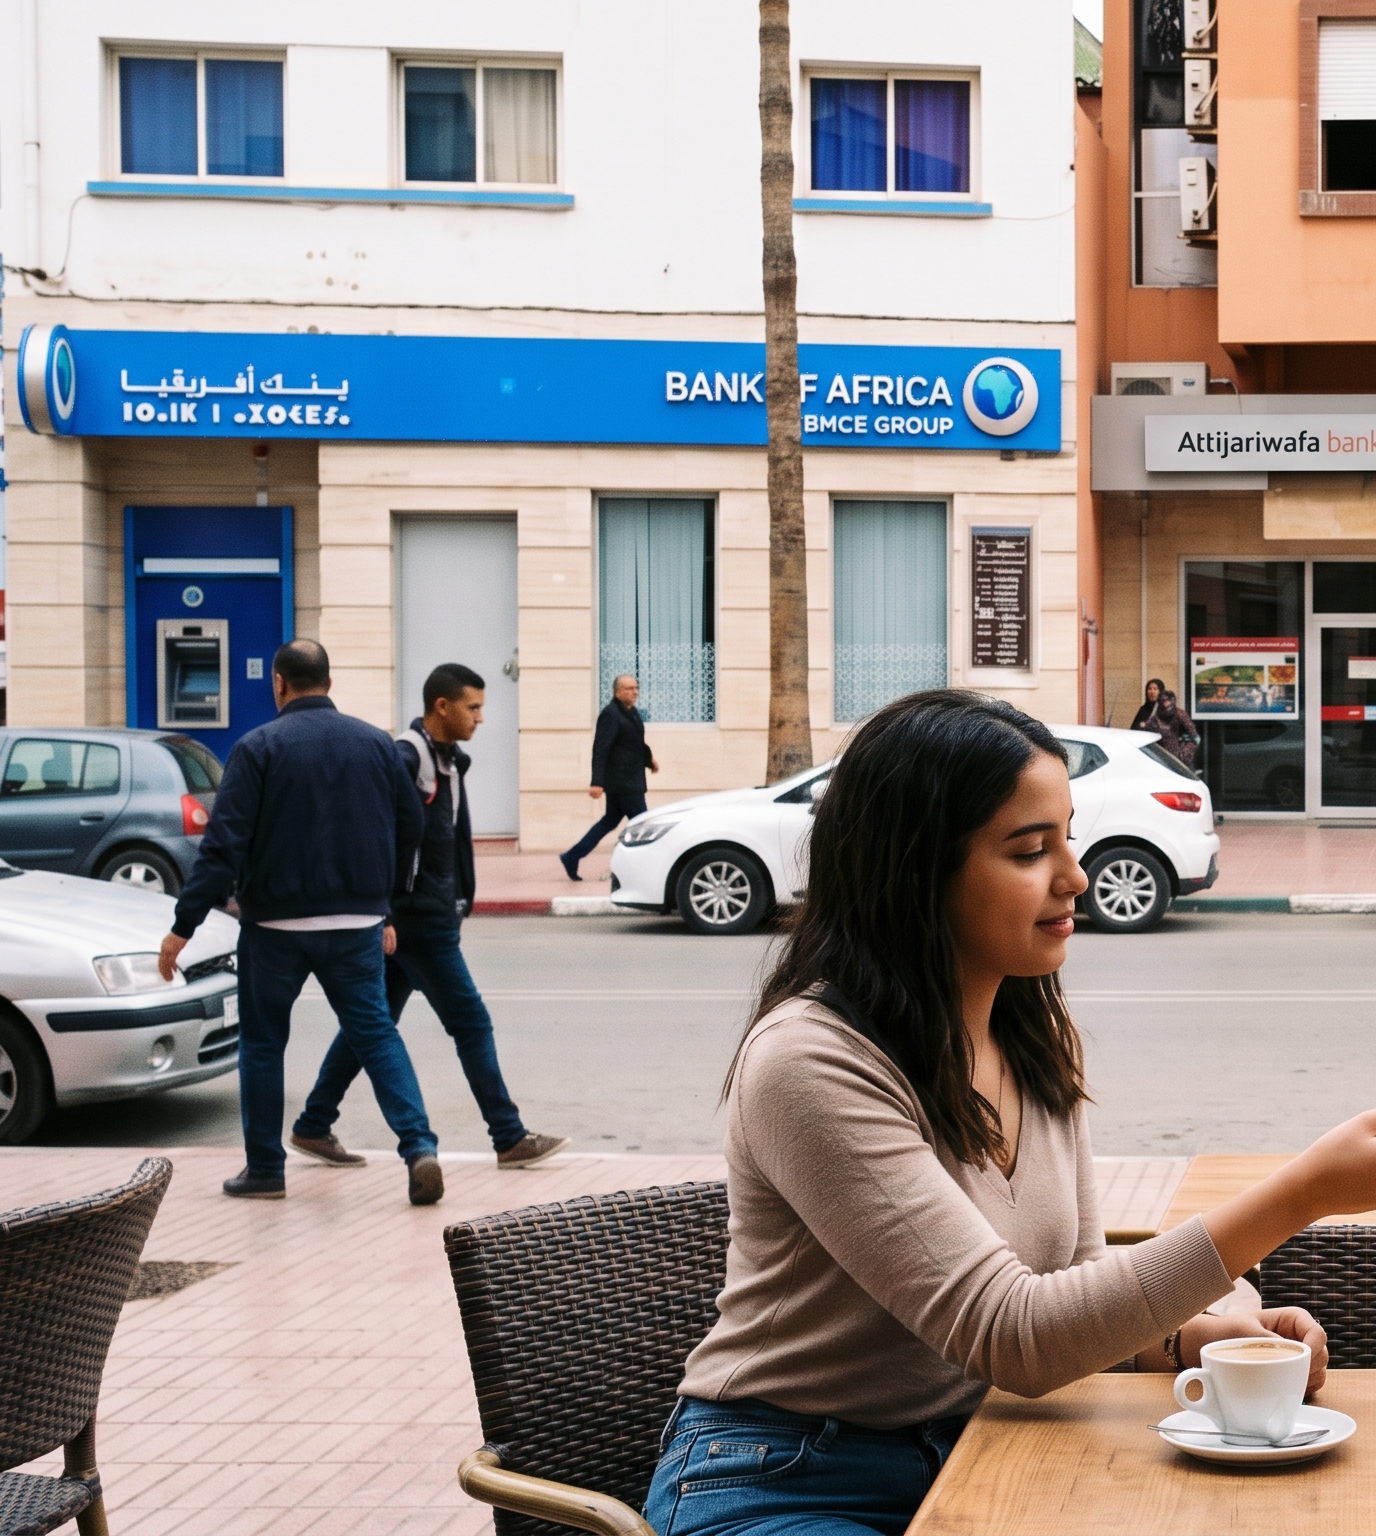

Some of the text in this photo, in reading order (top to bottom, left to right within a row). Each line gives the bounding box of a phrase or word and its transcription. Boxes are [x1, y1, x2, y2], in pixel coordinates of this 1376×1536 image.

[121, 364, 254, 398] أفريقيا
[666, 370, 954, 407] BANK F AFRICA
[804, 414, 954, 435] BMCE GROUP
[1177, 430, 1320, 459] Attijariwafa
